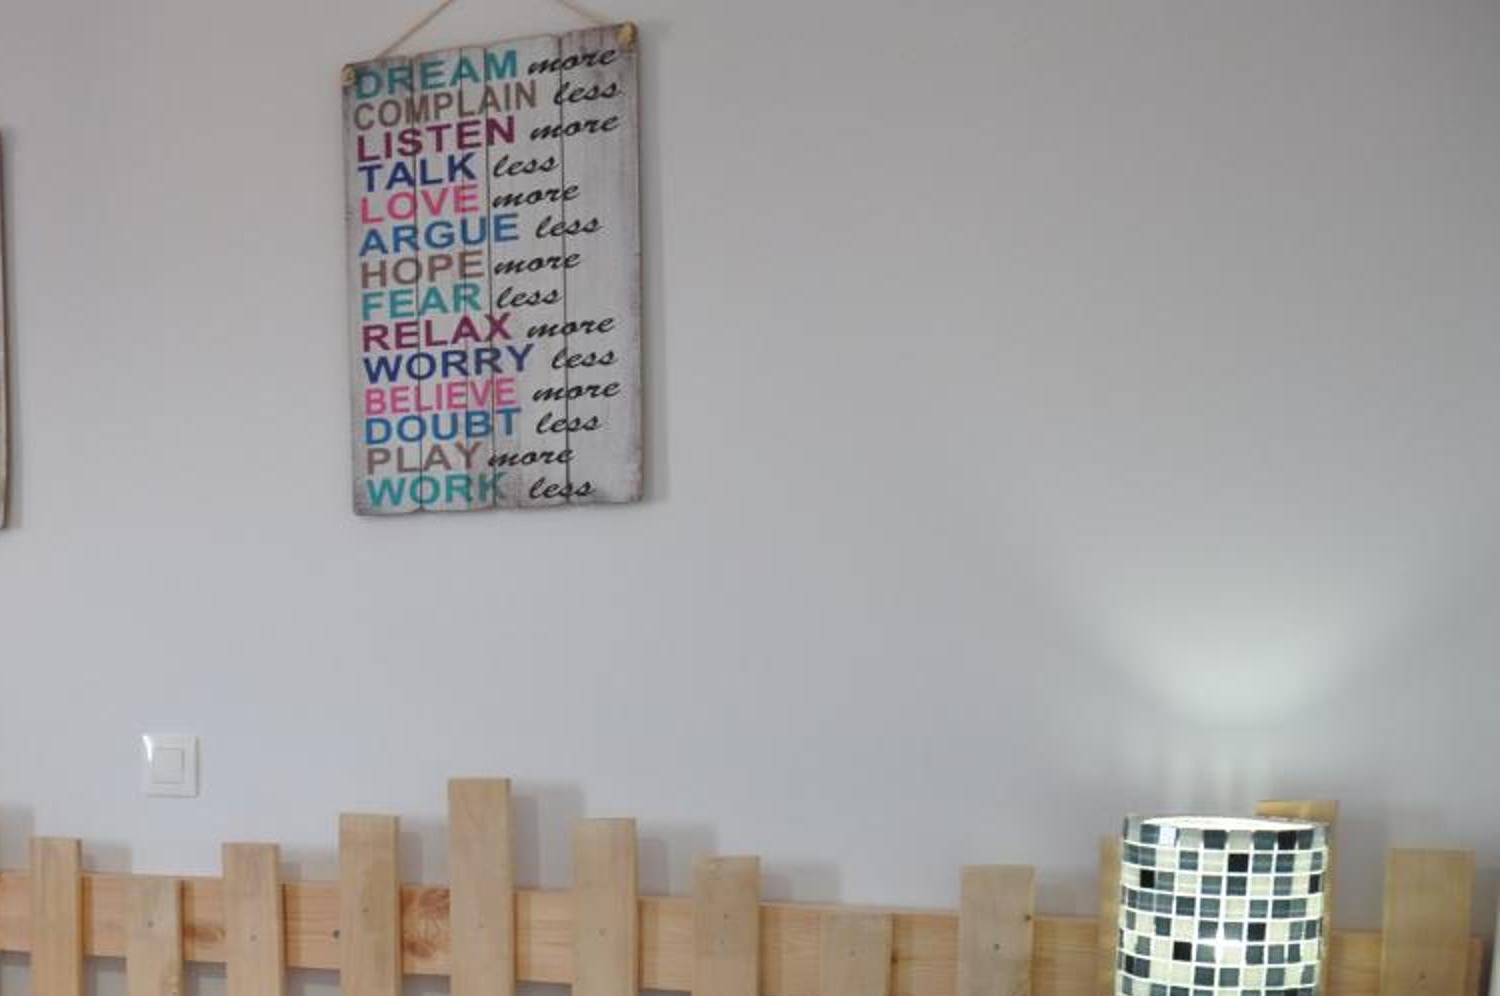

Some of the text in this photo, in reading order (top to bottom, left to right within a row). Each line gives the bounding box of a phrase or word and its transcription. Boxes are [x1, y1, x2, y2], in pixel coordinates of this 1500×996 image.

[356, 48, 616, 100] DREAM more
[354, 79, 620, 131] COMPLAIN less
[357, 113, 619, 163] LISTEN more
[357, 152, 558, 193] TALK less
[361, 184, 580, 225] LOVE more
[359, 213, 602, 257] ARGUE less
[361, 250, 581, 289] HOPE more
[361, 282, 561, 321] FEAR less
[362, 312, 615, 353] RELAX more
[363, 344, 617, 385] WORRY less
[364, 377, 621, 416] BELIEVE more
[365, 407, 601, 445] DOUBT less
[367, 441, 575, 475] PLAY more
[366, 471, 596, 507] WORK less
